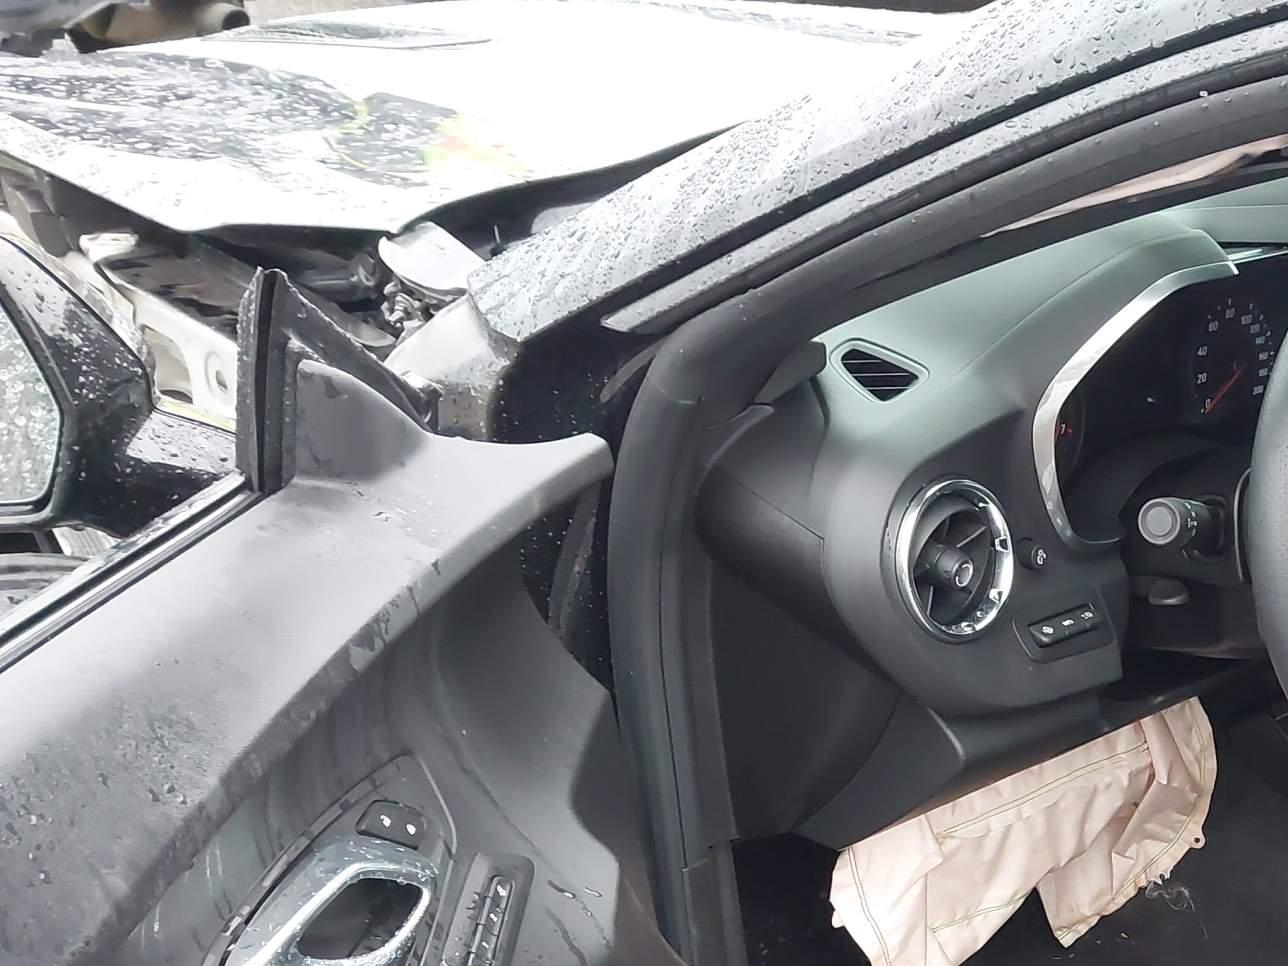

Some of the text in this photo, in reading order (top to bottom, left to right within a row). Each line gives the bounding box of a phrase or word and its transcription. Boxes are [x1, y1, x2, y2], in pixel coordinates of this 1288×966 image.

[1209, 321, 1218, 332] 60
[1197, 346, 1208, 356] 40
[1197, 373, 1207, 384] 20
